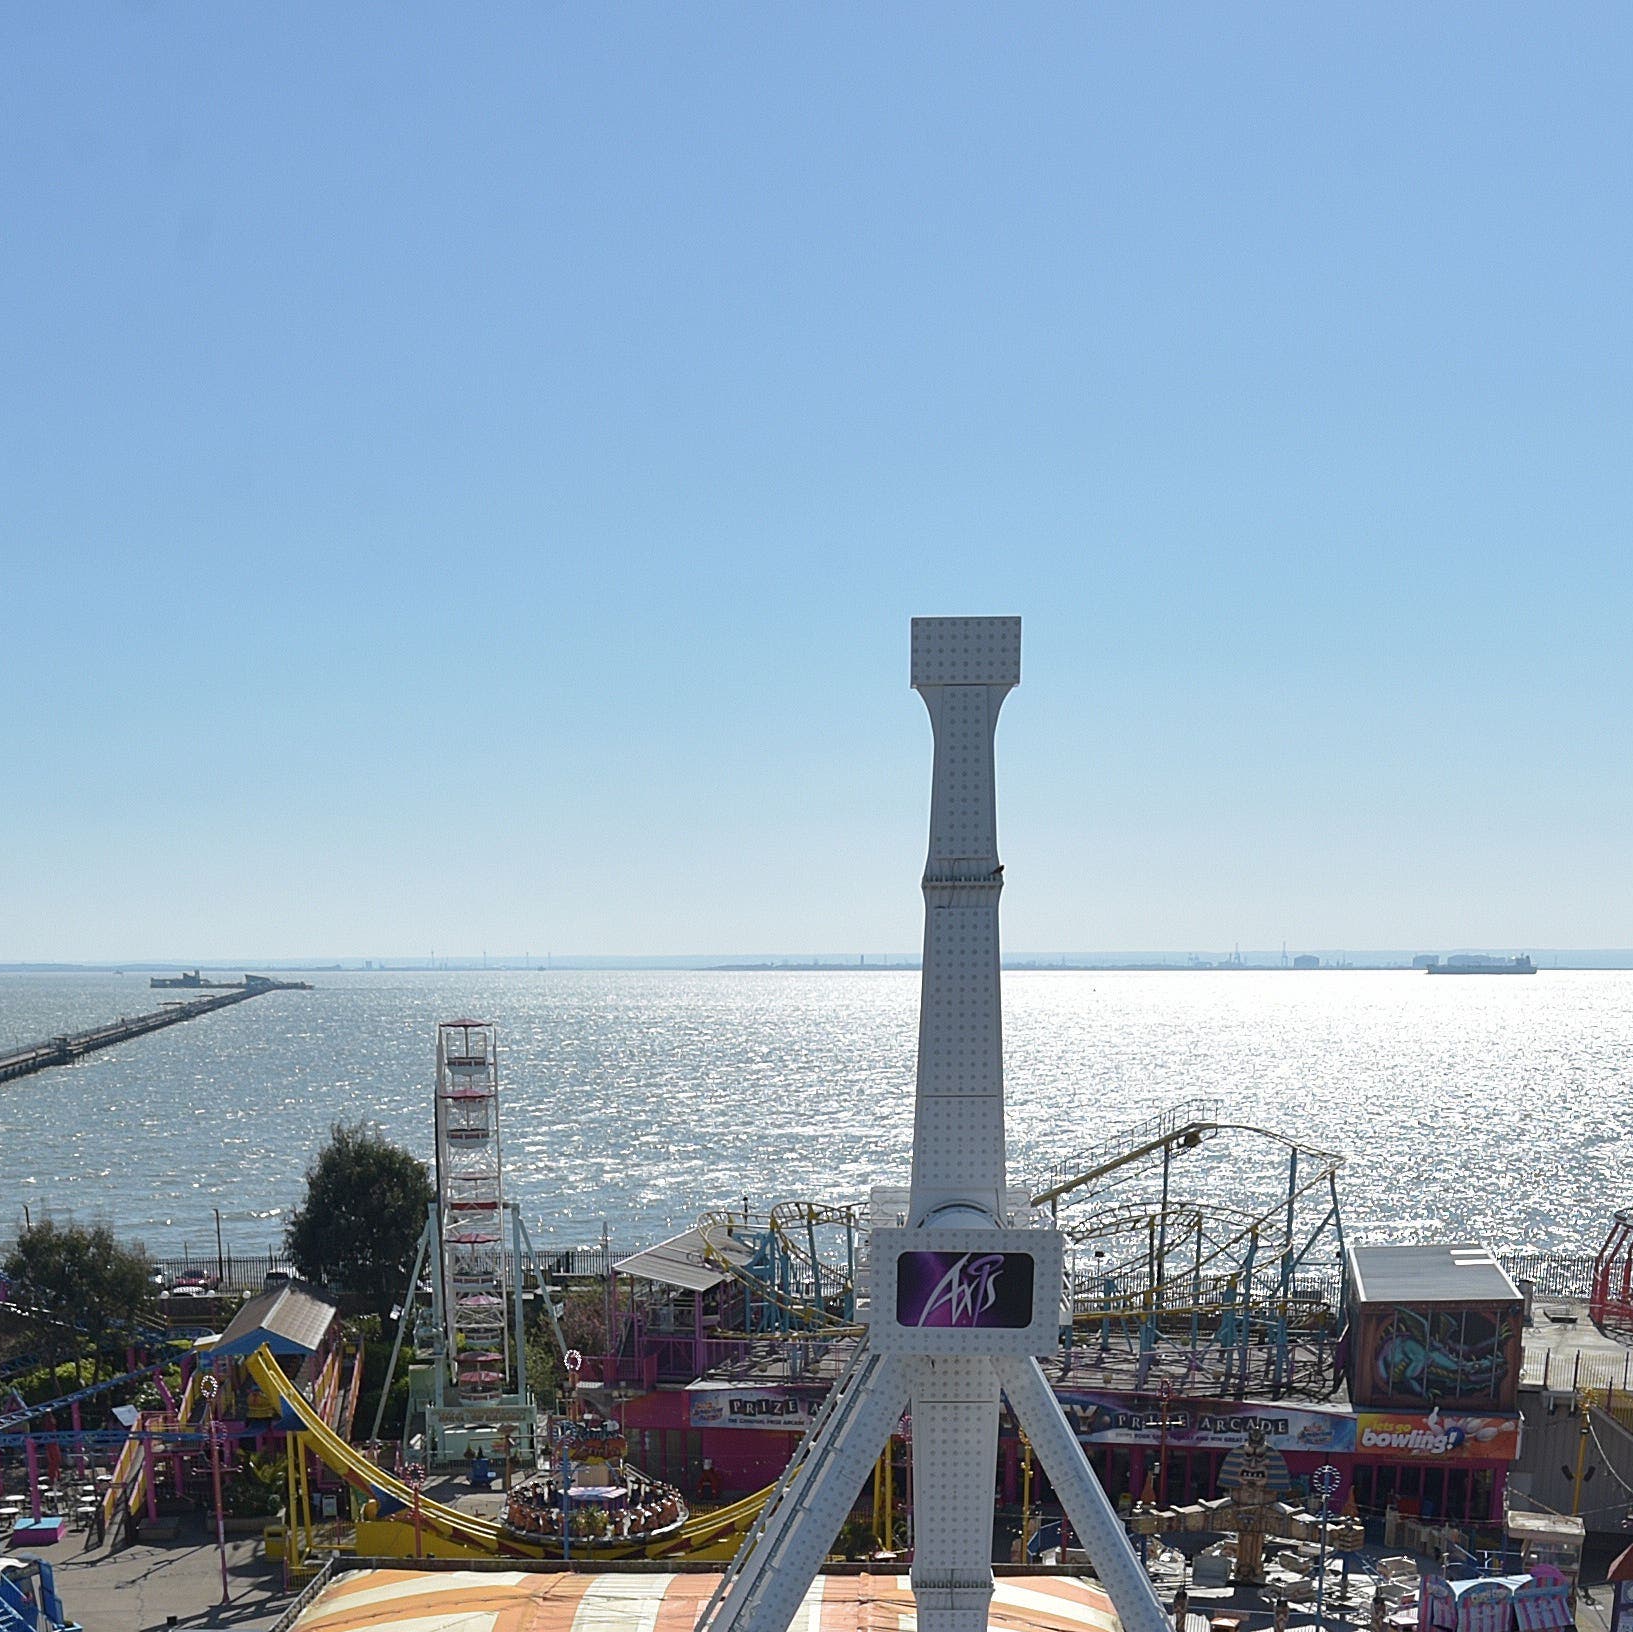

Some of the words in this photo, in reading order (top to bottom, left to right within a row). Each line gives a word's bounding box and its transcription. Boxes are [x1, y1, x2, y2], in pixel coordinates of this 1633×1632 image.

[734, 1398, 796, 1414] PRIZE
[1201, 1416, 1287, 1432] ARCADE
[1362, 1428, 1458, 1454] bowling!
